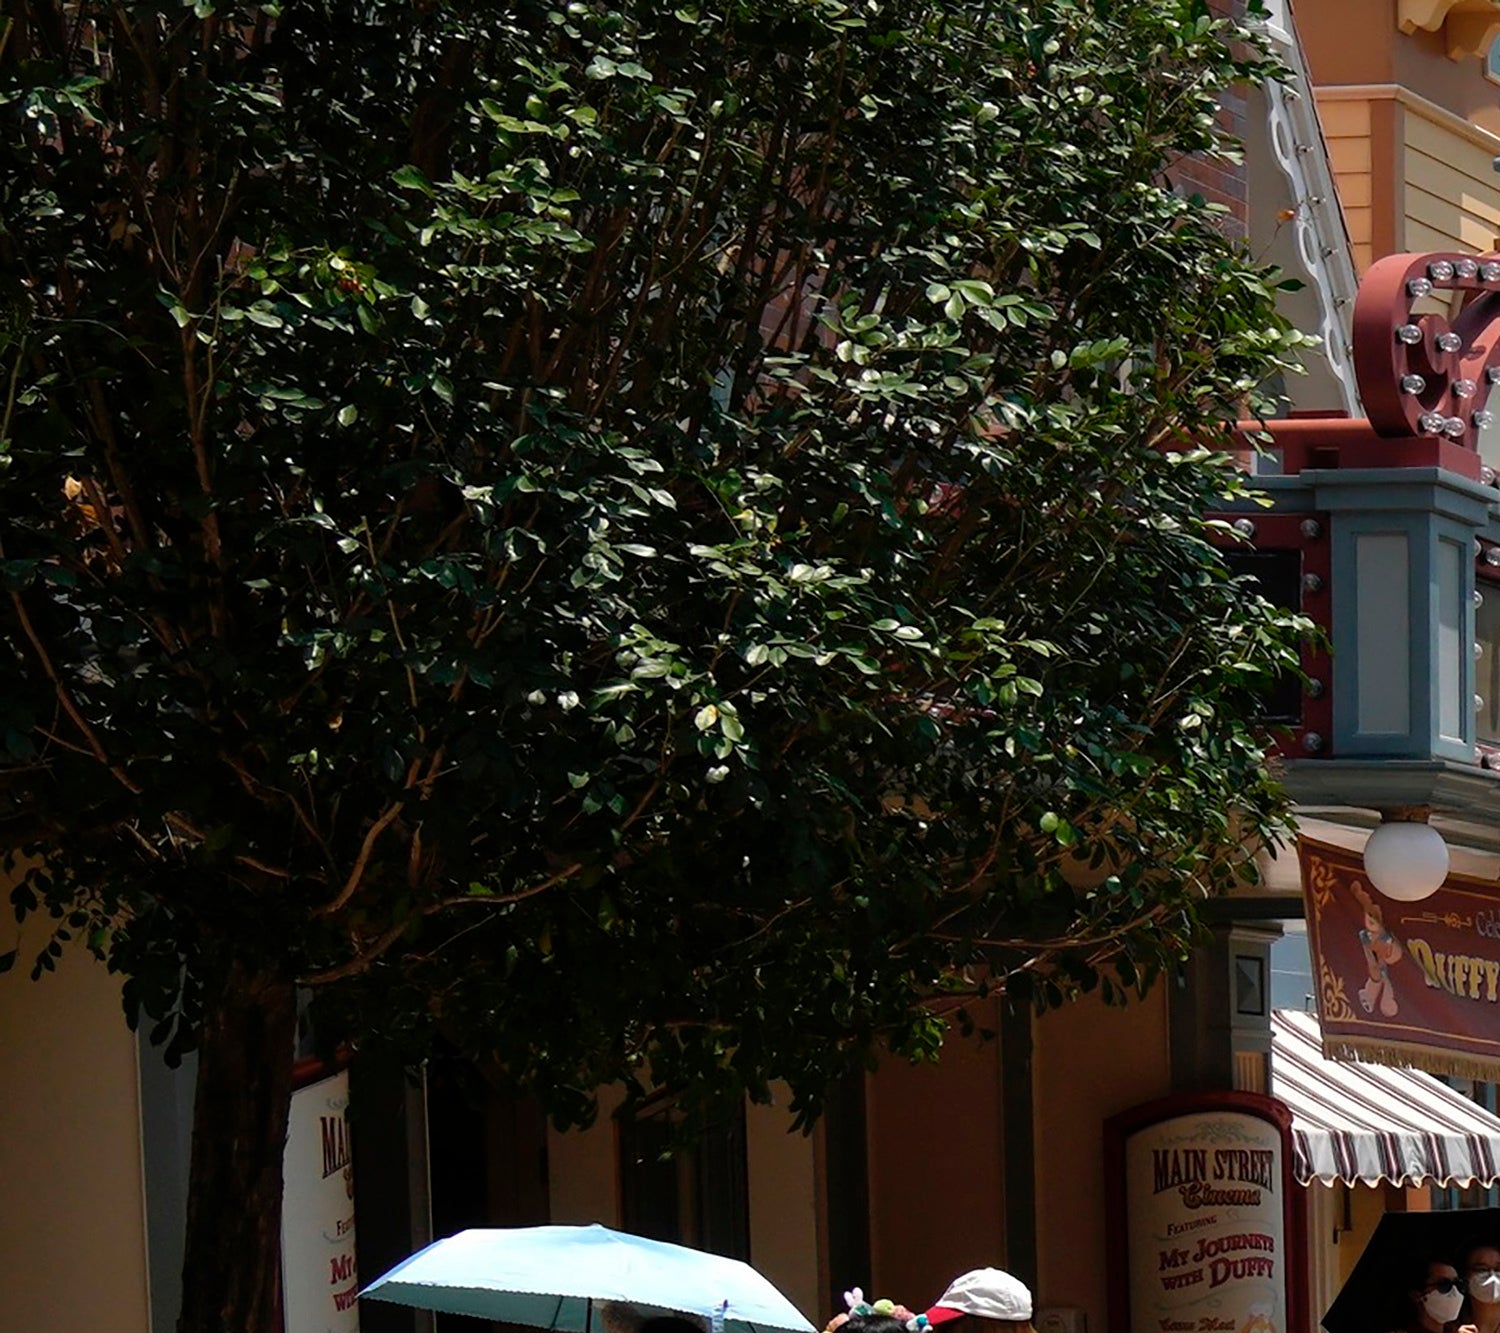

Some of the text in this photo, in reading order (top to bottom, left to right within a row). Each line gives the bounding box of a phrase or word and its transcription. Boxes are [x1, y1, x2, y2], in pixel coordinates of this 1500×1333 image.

[1152, 1148, 1274, 1195] MAIN STREET
[1178, 1181, 1261, 1210] Cinema
[1158, 1233, 1275, 1271] MY JOURNEYS
[1160, 1256, 1275, 1291] WITH DUFFY
